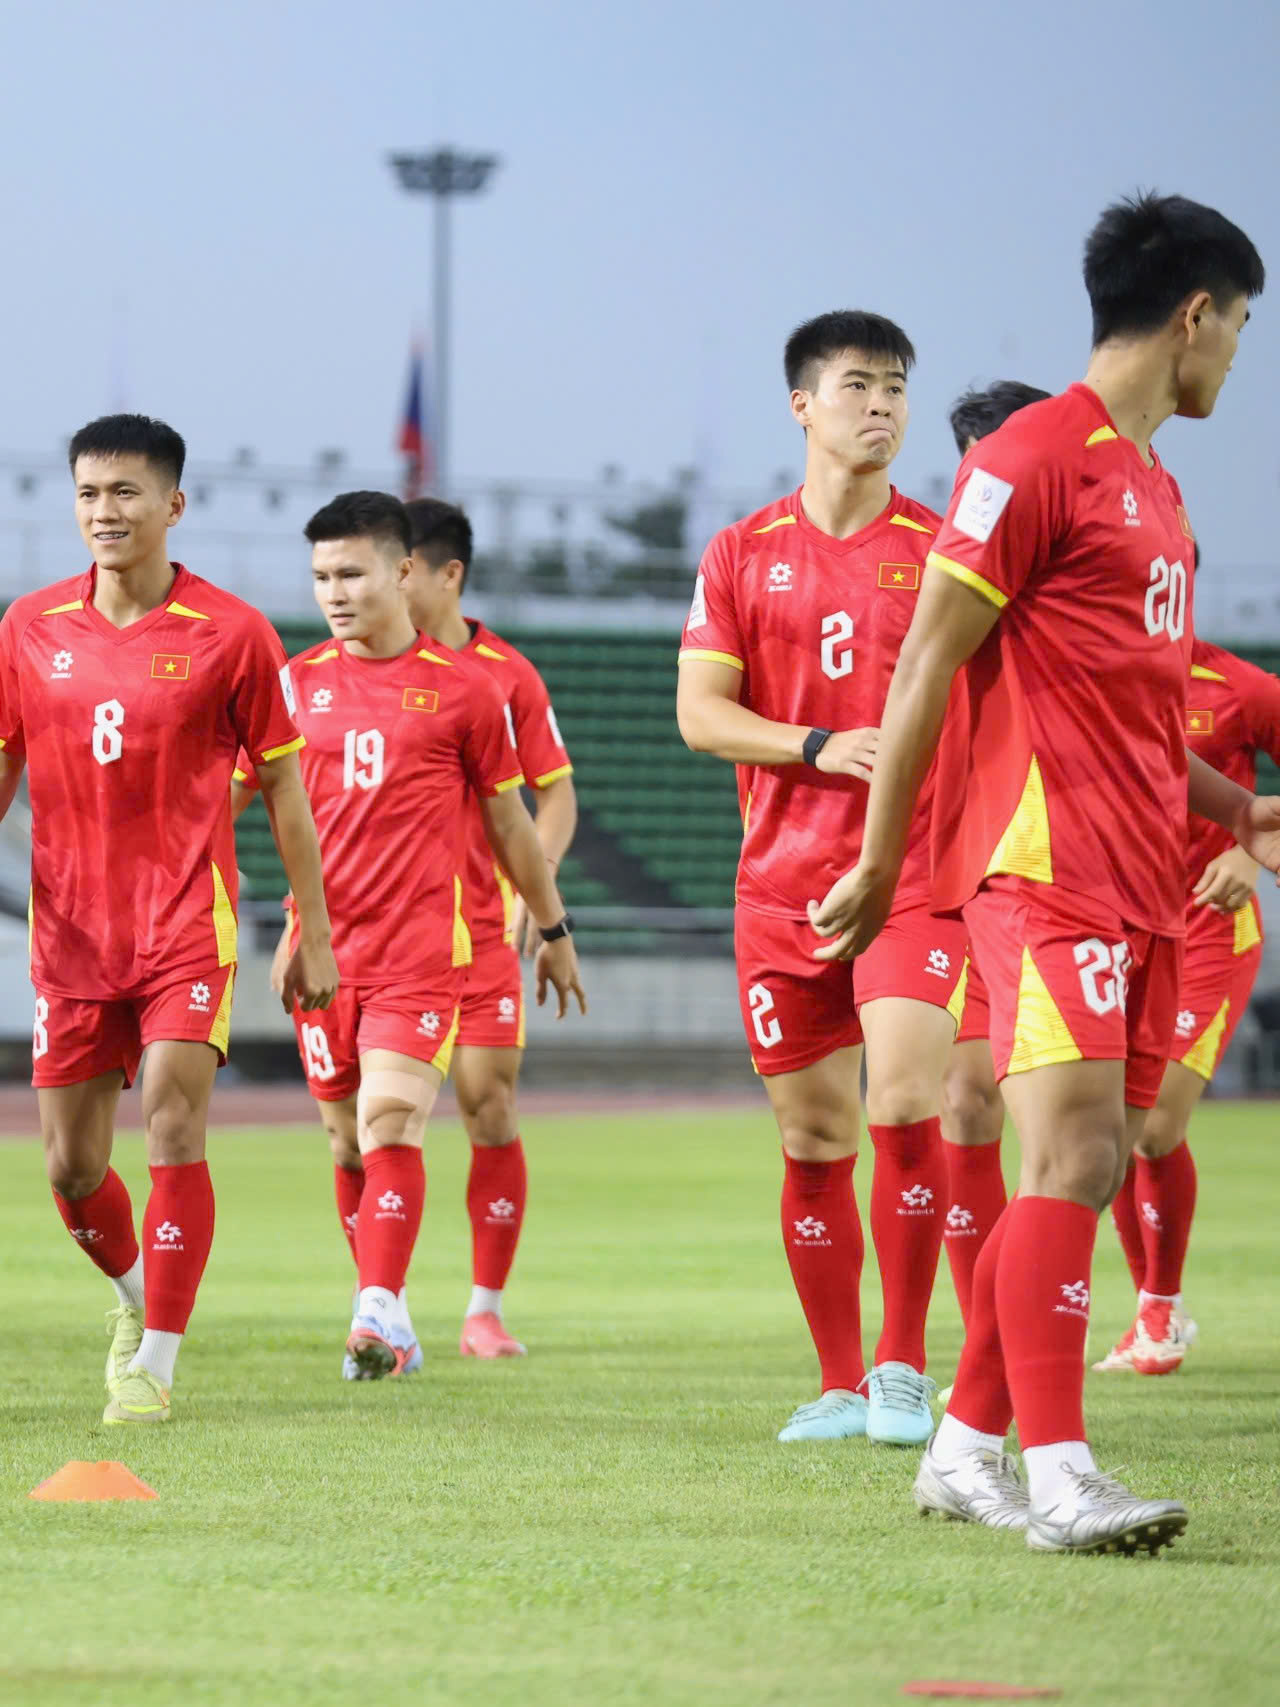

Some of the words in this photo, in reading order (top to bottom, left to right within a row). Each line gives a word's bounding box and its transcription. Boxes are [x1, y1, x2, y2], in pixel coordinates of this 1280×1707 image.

[1144, 554, 1187, 643] 20
[821, 610, 854, 681] 2
[92, 698, 125, 766] 8
[343, 728, 385, 789] 19
[33, 996, 49, 1060] 8
[748, 983, 784, 1049] 2
[301, 1022, 336, 1080] 19
